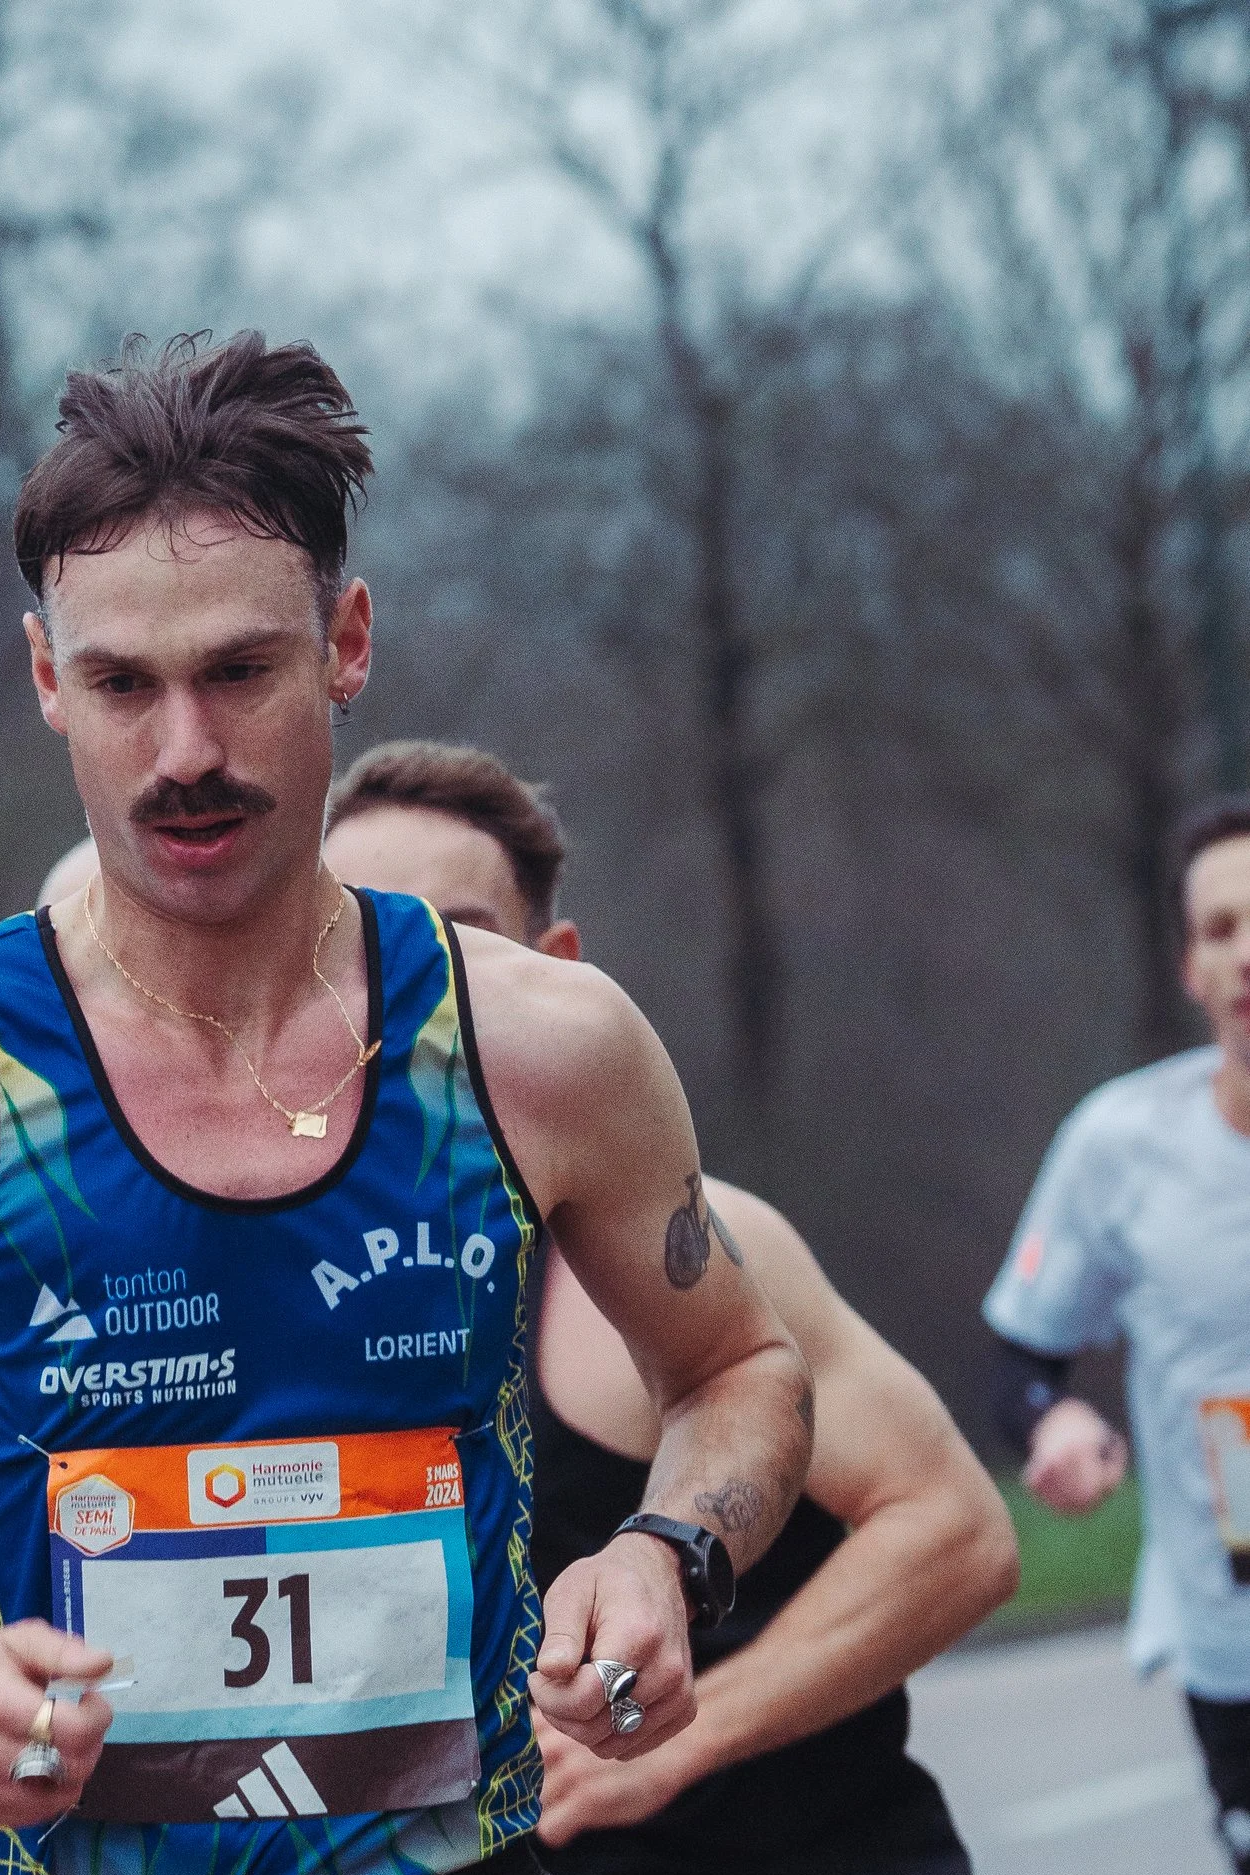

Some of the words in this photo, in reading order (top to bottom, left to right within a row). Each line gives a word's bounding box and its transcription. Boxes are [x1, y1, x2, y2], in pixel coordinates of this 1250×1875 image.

[103, 1267, 187, 1300] tonton
[105, 1293, 221, 1336] OUTDOOR
[365, 1328, 471, 1362] LORIENT
[81, 1389, 144, 1407] SPORTS
[152, 1379, 238, 1404] NUTRITION
[252, 1459, 323, 1475] Harmonie
[253, 1472, 324, 1488] mutuelle
[425, 1466, 433, 1482] 3
[434, 1462, 459, 1481] MARS
[425, 1480, 461, 1507] 2024
[222, 1573, 313, 1690] 31
